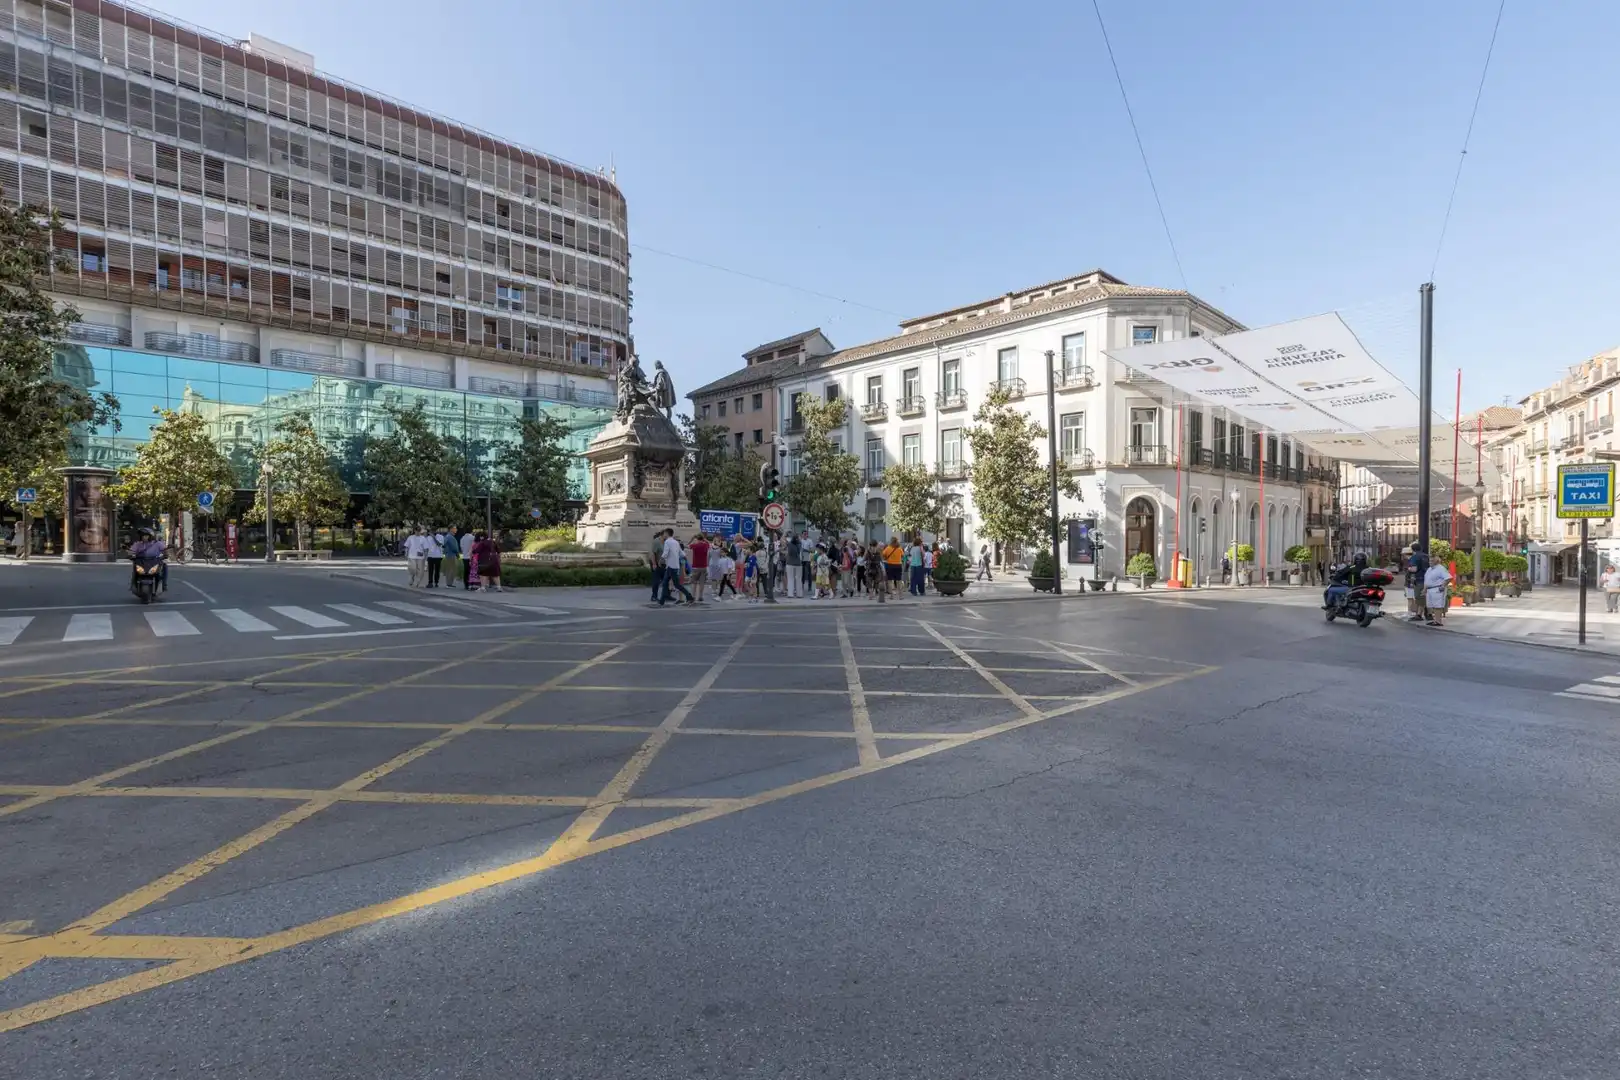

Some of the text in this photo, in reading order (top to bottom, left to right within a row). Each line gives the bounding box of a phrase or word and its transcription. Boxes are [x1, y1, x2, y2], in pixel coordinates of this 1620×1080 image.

[1265, 348, 1336, 363] CERVEZAS
[1267, 353, 1346, 368] ALHAMBRA
[1570, 492, 1601, 500] TAXI
[702, 514, 734, 524] atlanta
